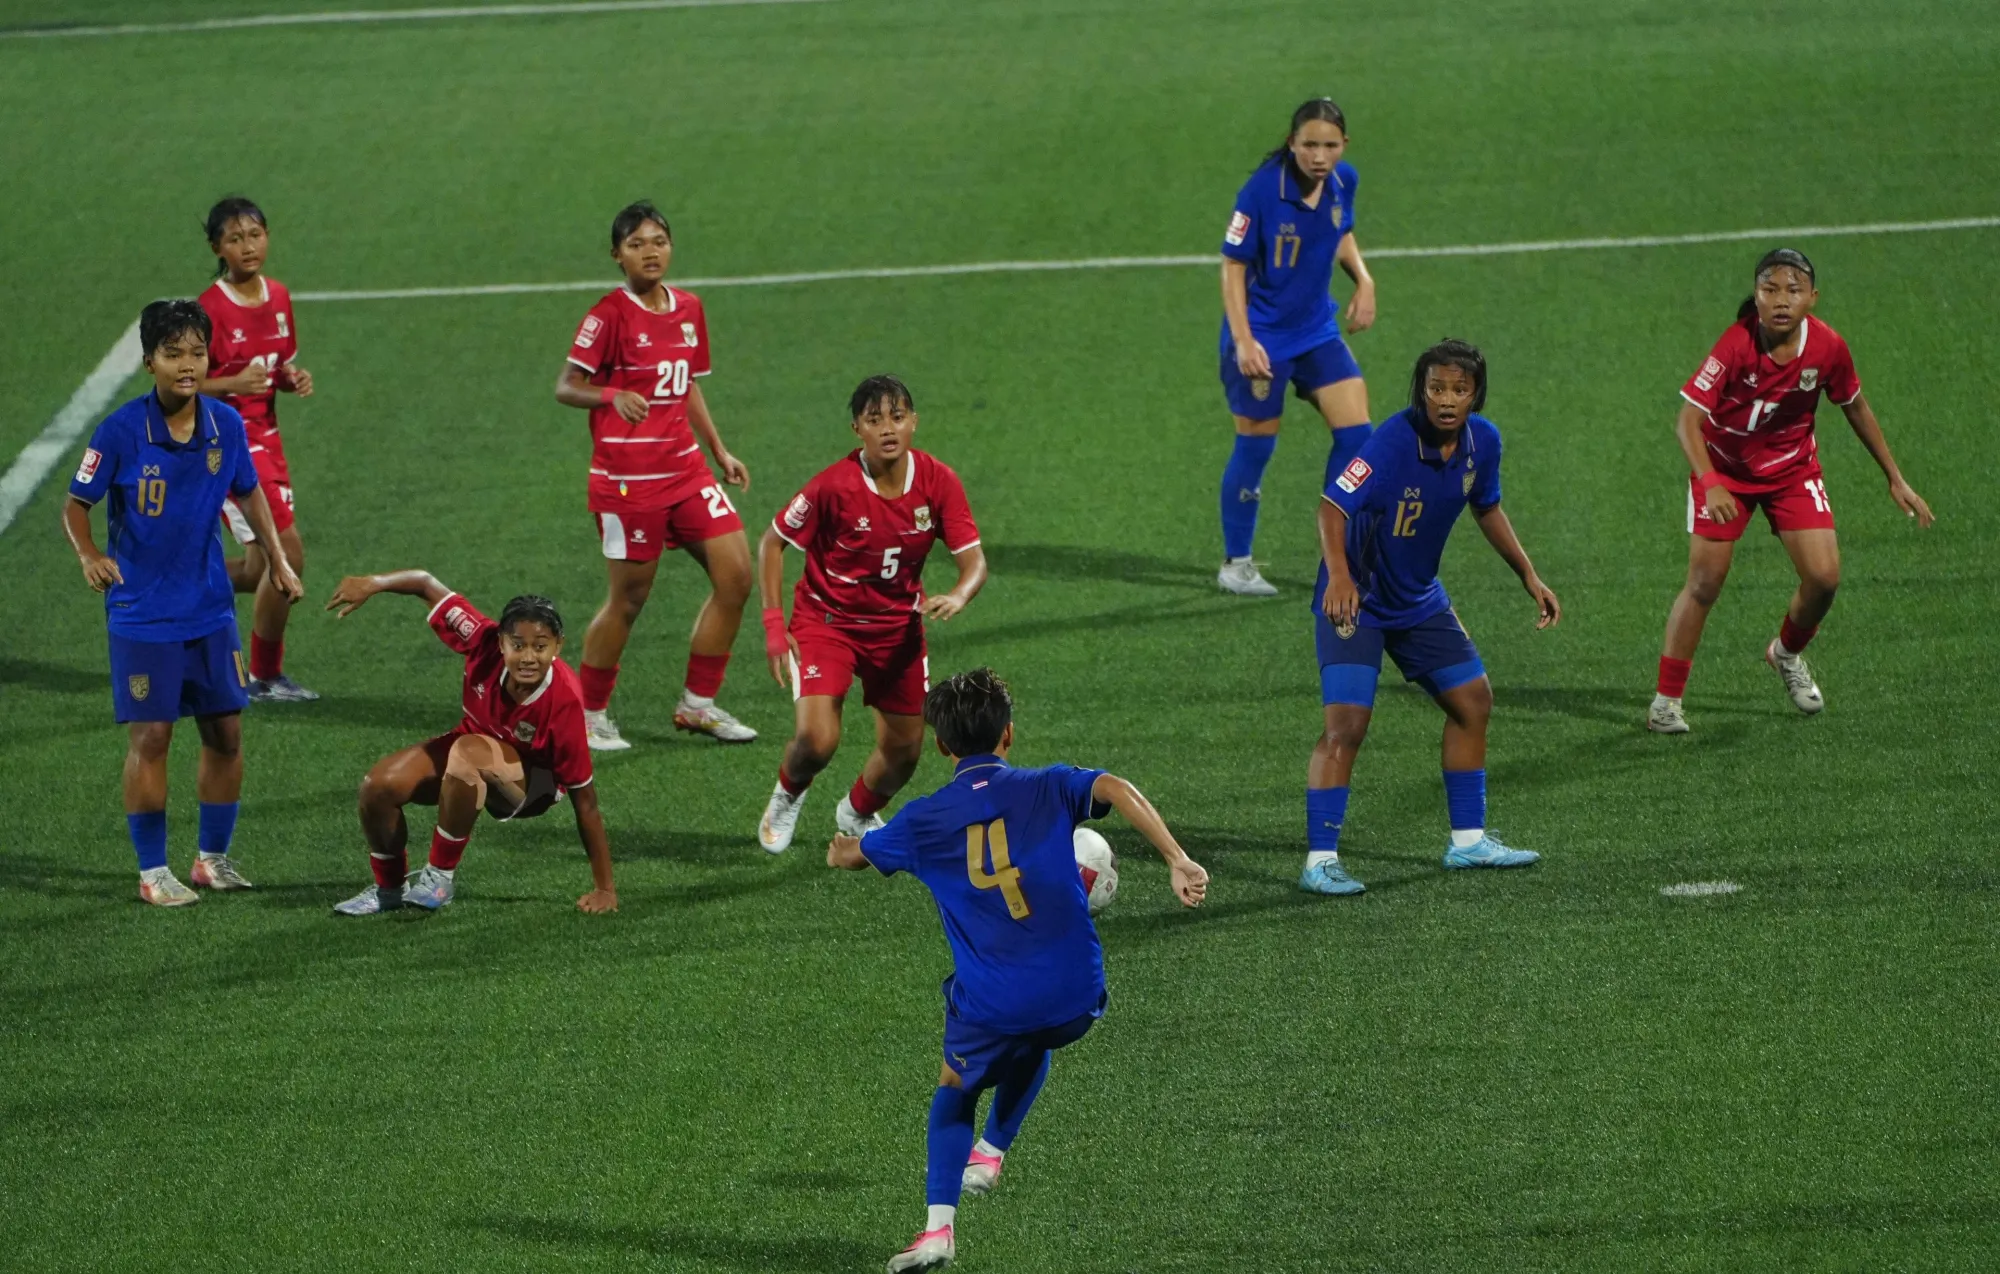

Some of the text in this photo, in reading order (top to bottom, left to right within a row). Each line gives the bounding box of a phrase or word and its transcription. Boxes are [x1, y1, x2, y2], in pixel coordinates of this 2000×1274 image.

[1274, 235, 1301, 268] 17
[654, 359, 689, 397] 20
[137, 478, 166, 517] 19
[1393, 500, 1424, 537] 12
[880, 547, 902, 579] 5
[966, 817, 1031, 920] 4
